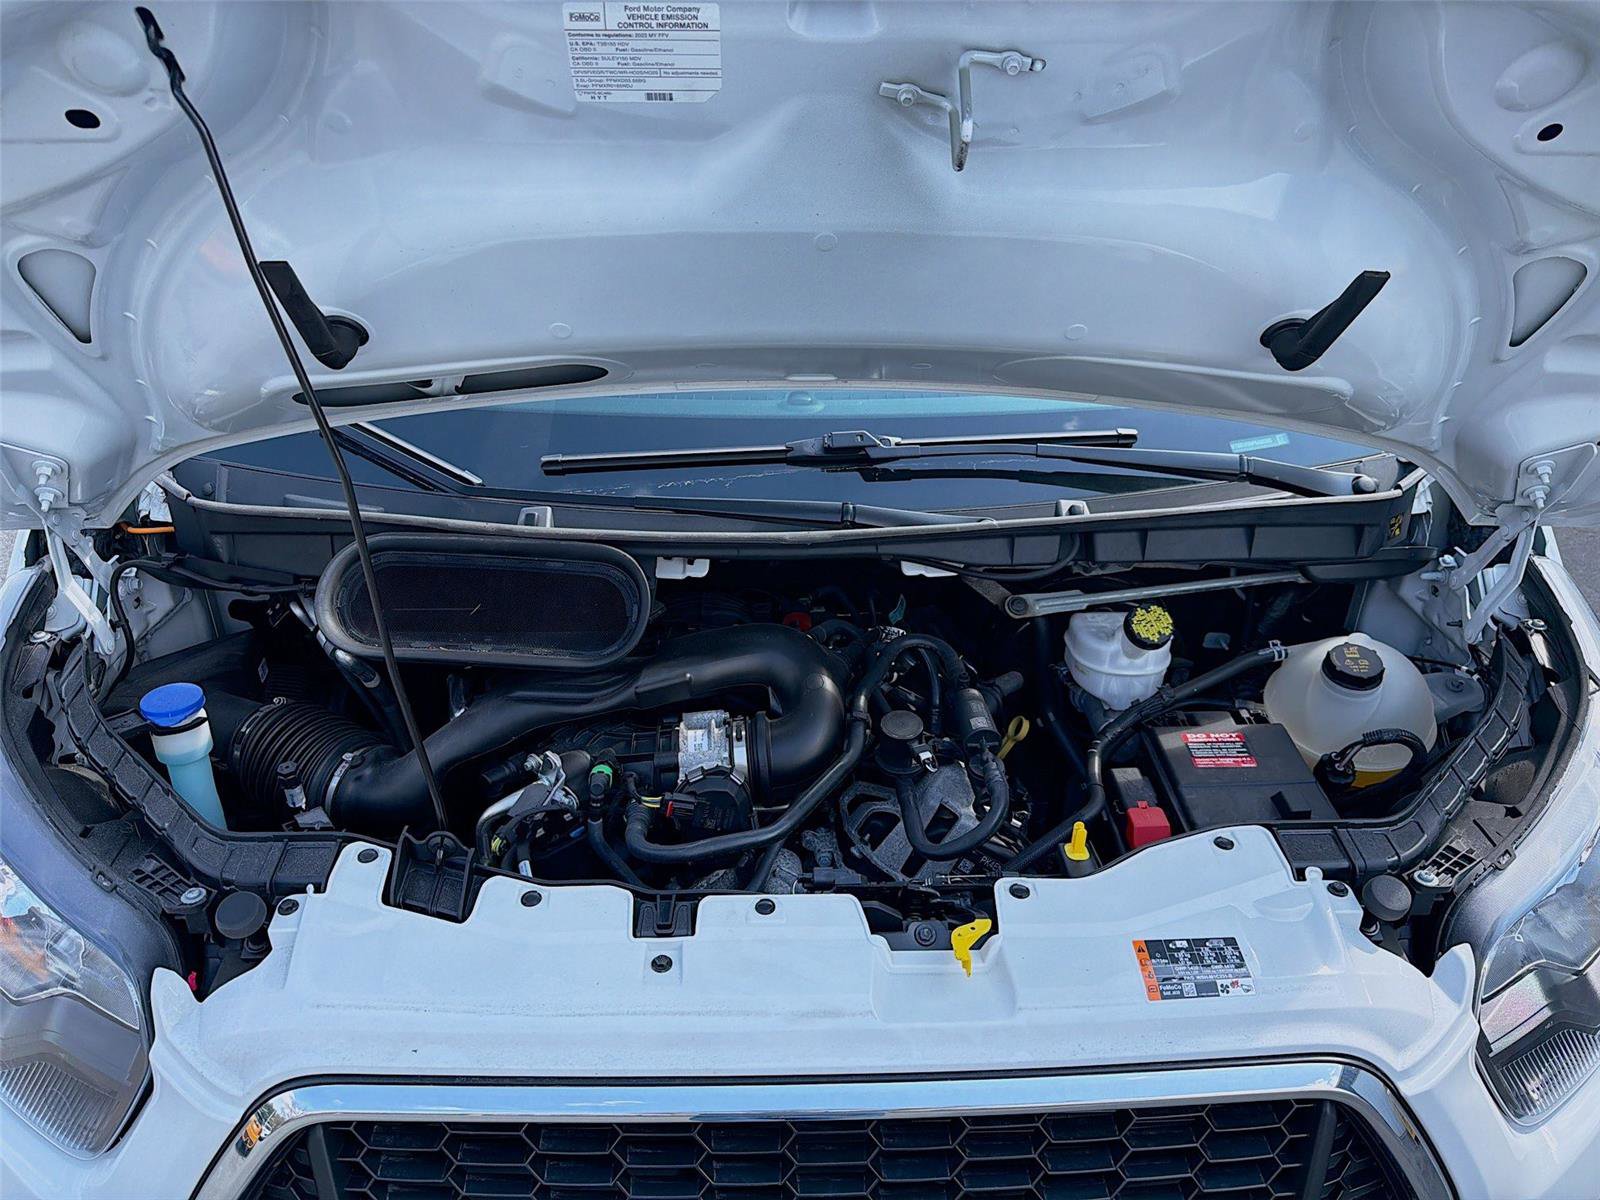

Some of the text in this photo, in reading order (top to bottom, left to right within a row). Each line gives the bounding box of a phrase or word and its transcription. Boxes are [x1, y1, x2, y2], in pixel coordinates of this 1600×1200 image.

[624, 5, 700, 14] Ford Motor Company
[569, 12, 600, 22] FoMoCo
